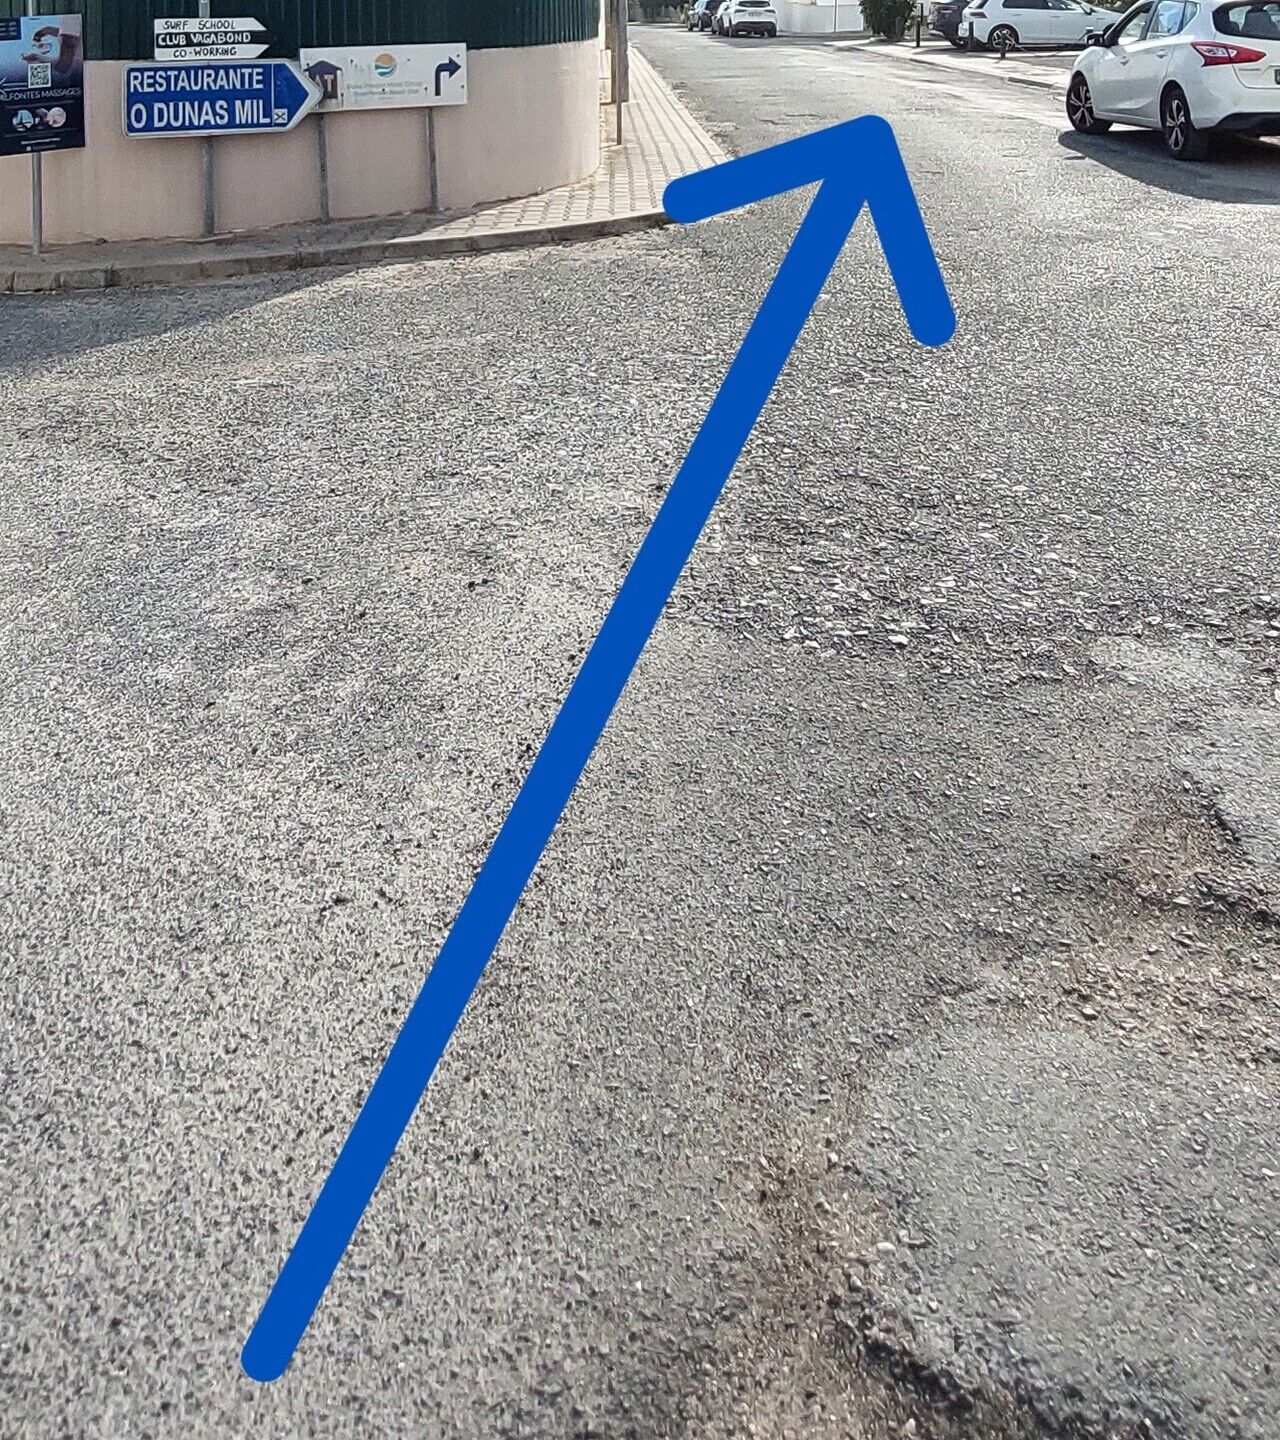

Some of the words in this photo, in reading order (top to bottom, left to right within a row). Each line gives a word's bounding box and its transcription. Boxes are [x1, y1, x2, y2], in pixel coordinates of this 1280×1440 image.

[163, 20, 189, 30] SURF
[198, 20, 236, 30] SCHOOL
[158, 34, 186, 46] CLUB
[190, 32, 251, 44] VAGABOND
[129, 68, 264, 93] RESTAURANTE
[130, 103, 147, 129] O
[153, 100, 228, 128] DUNAS
[235, 99, 271, 124] MIL
